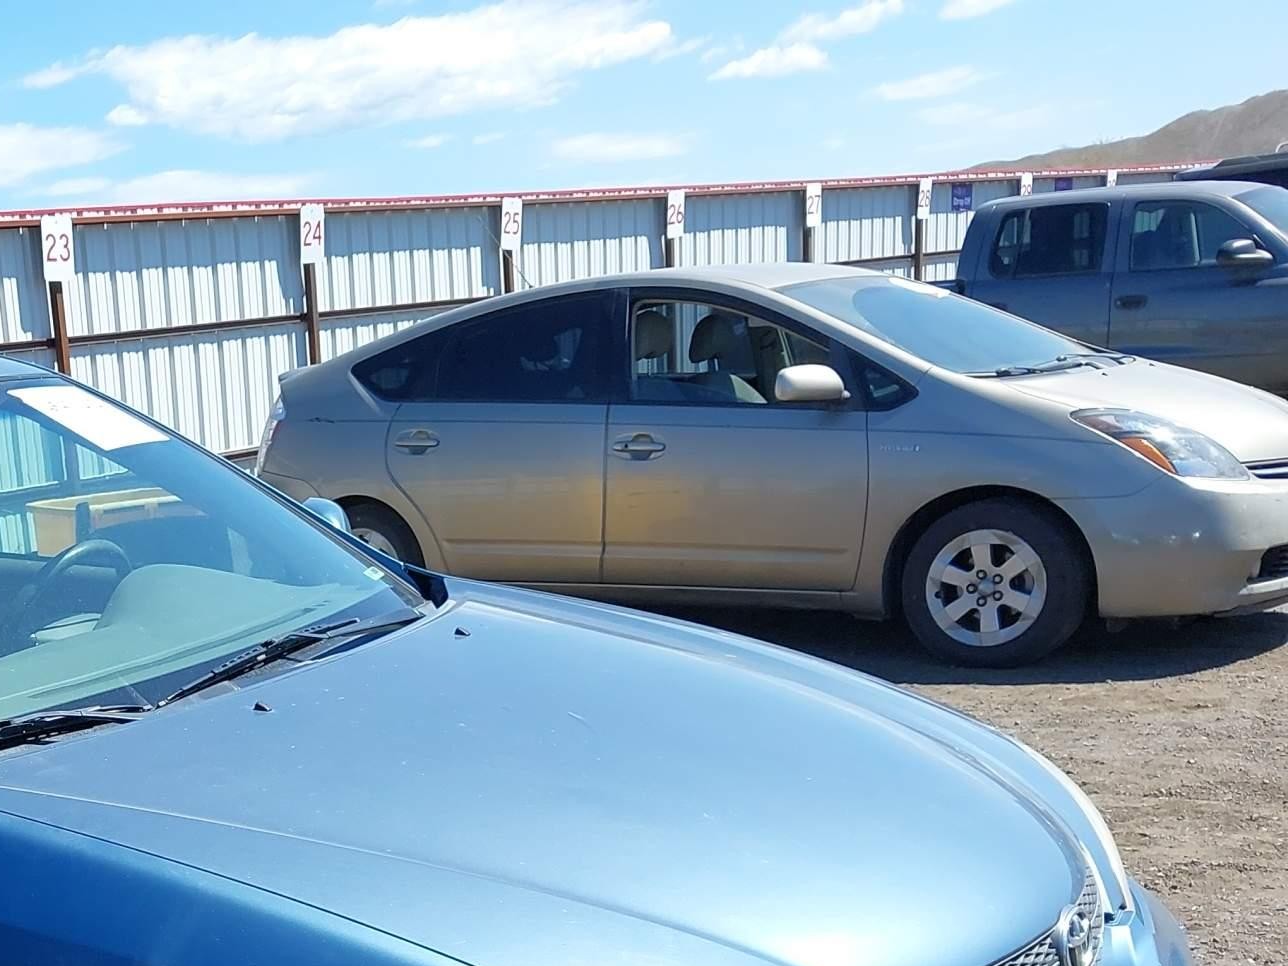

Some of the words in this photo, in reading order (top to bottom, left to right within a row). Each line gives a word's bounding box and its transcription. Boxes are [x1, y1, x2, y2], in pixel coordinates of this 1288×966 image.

[667, 204, 684, 225] 26
[807, 195, 821, 214] 27
[303, 220, 322, 246] 24
[503, 212, 520, 235] 25
[45, 233, 71, 262] 23
